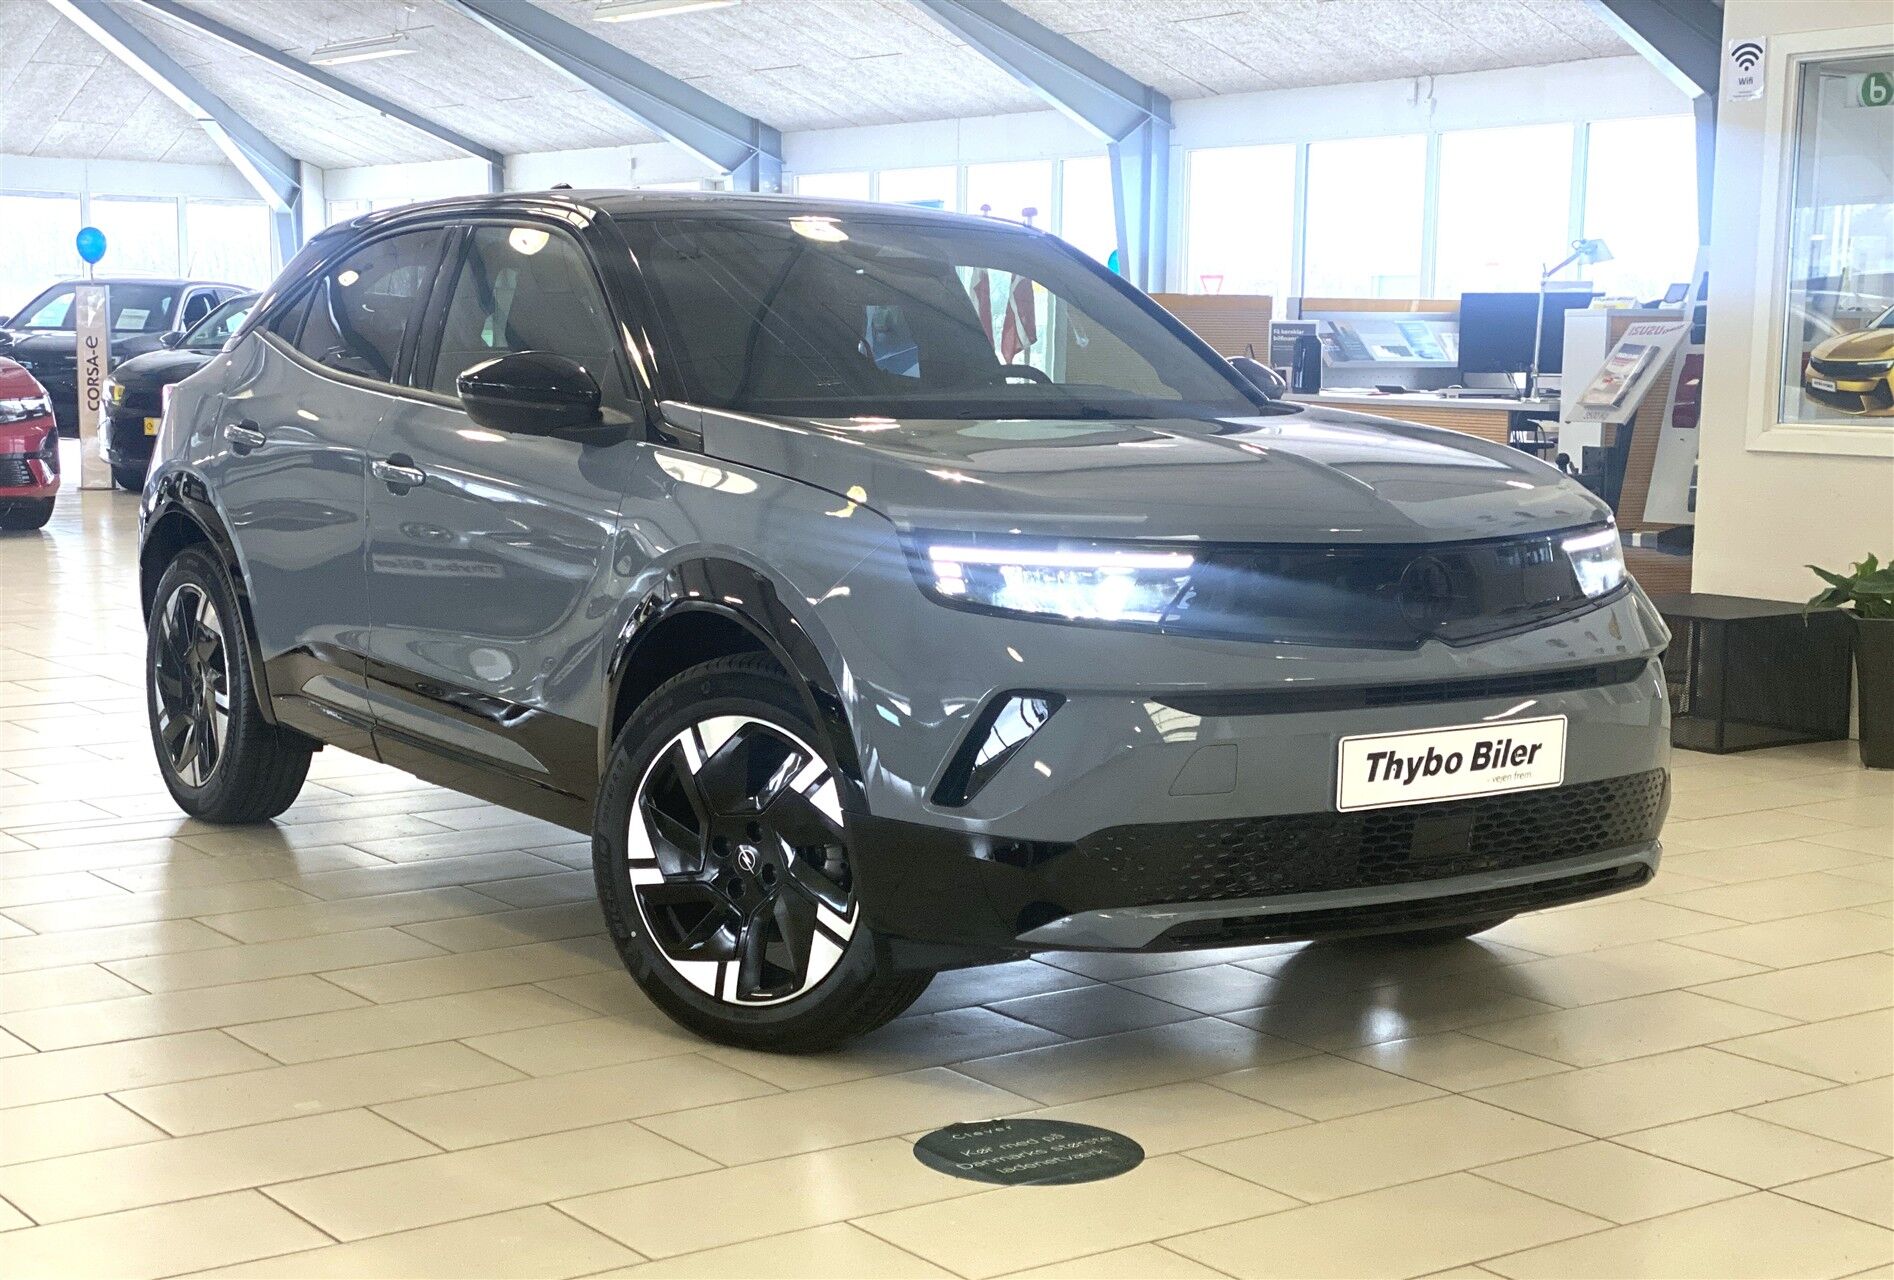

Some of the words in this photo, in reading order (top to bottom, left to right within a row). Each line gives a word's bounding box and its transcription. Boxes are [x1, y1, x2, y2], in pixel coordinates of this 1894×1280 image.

[1628, 325, 1664, 336] ISUZU
[86, 335, 100, 411] CORSA-e
[1366, 747, 1464, 786] Thybo
[1469, 738, 1543, 772] Biler
[1492, 773, 1512, 784] vejen
[952, 1125, 1012, 1140] Clever
[1000, 1138, 1039, 1149] med
[956, 1149, 1048, 1170] Danmarks
